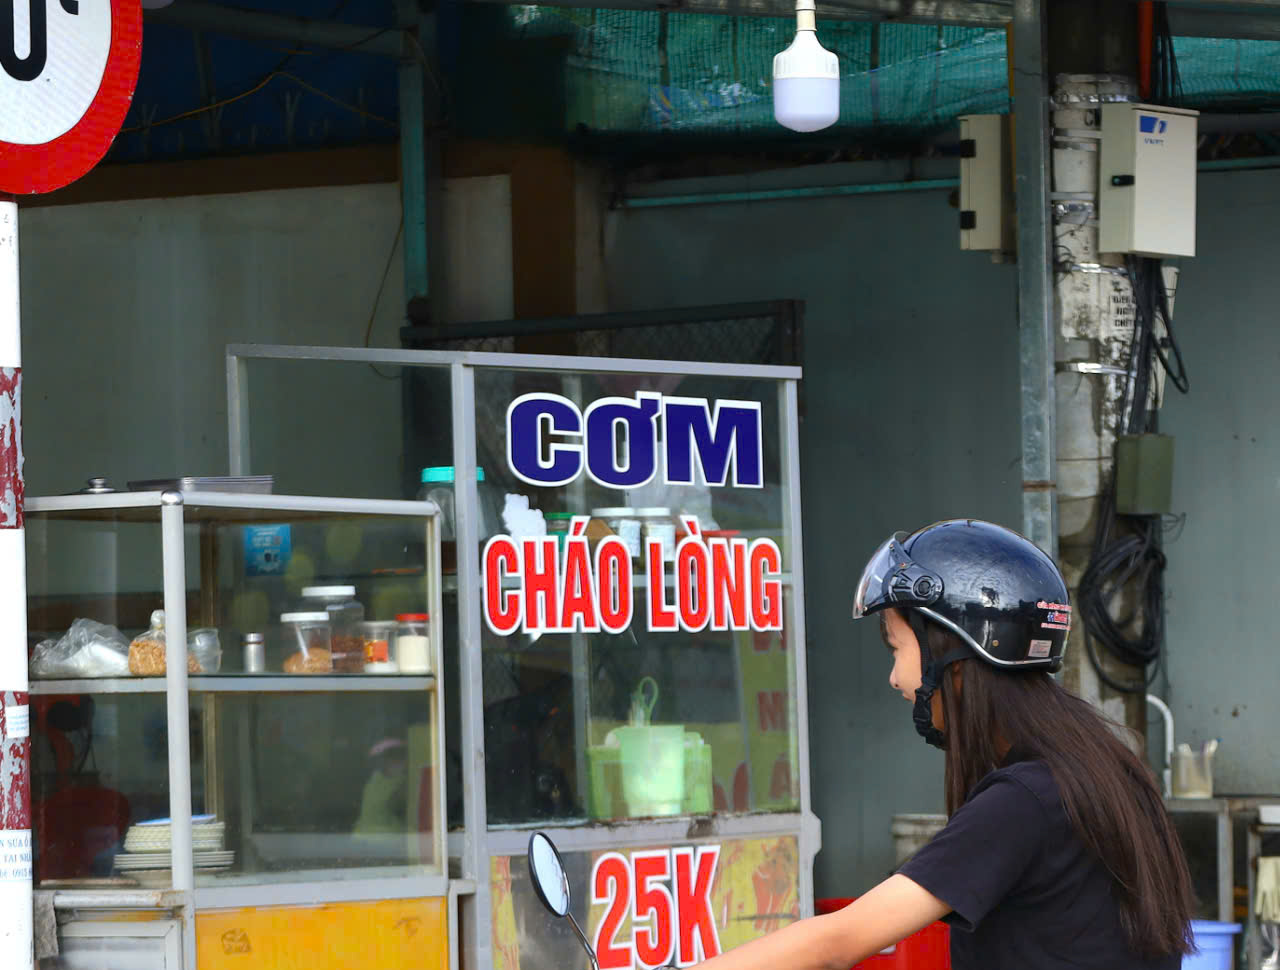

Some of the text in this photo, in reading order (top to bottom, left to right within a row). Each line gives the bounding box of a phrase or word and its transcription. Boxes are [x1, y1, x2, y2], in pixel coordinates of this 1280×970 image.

[507, 392, 762, 488] CƠM
[485, 515, 782, 633] CHÁO LÒNG
